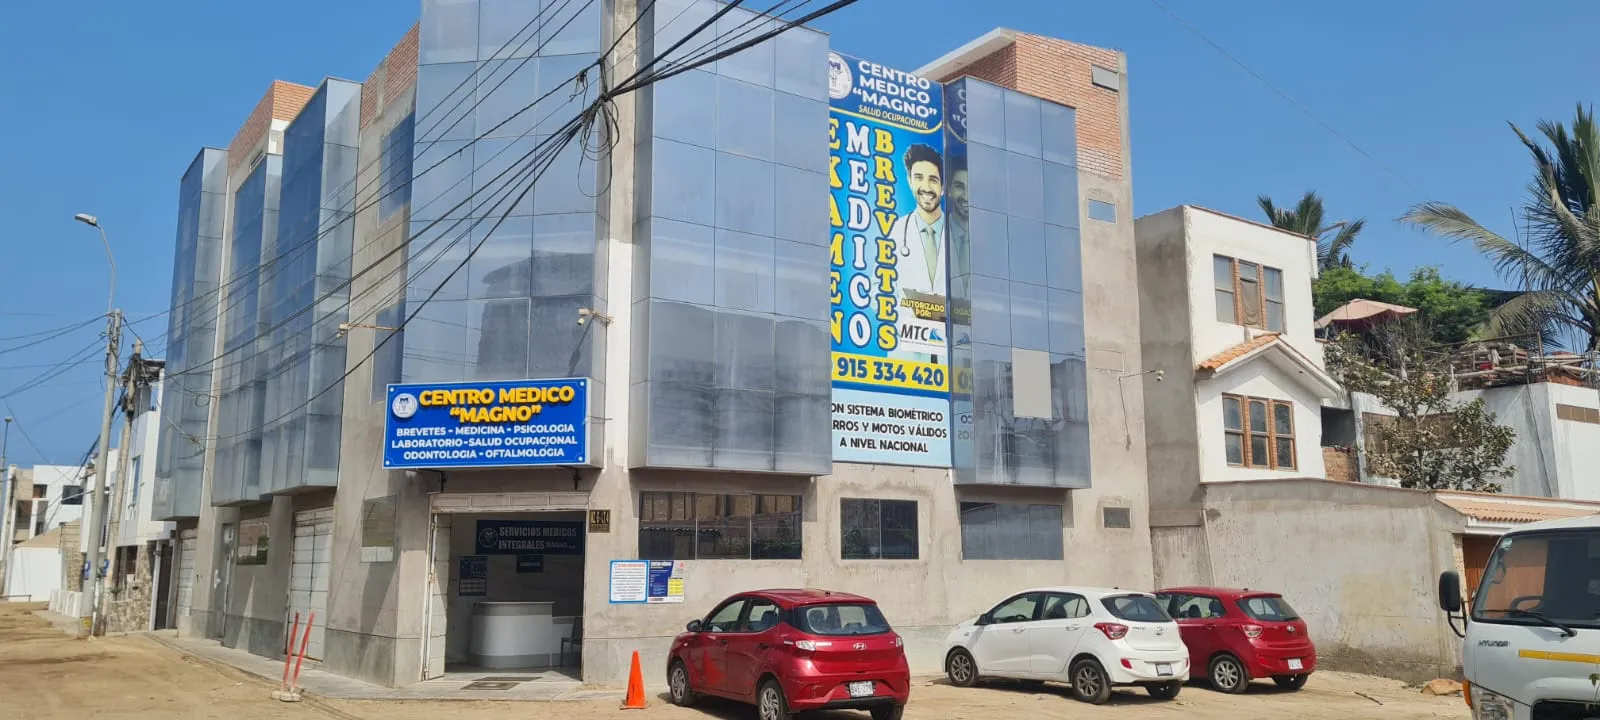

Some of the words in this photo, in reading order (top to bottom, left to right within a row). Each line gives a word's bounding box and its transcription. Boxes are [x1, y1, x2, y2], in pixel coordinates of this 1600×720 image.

[858, 60, 930, 90] CENTRO
[859, 75, 930, 103] MEDICO
[858, 104, 881, 118] SALUD
[882, 111, 928, 130] OCUPACIONAL
[875, 129, 896, 349] BREVETES
[901, 299, 944, 313] AUTORIZADO
[900, 324, 929, 341] MTC
[837, 357, 867, 379] 915
[873, 360, 906, 382] 334
[911, 367, 944, 386] 420
[419, 389, 495, 406] CENTRO
[499, 386, 575, 404] MEDICO
[832, 403, 844, 414] ON
[847, 404, 885, 418] SISTEMA
[888, 408, 943, 422] BIOMÉTRICO
[397, 427, 446, 437] BREVETES
[456, 425, 505, 436] MEDICINA
[514, 424, 574, 434] PSICOLOGIA
[832, 420, 859, 432] RROS
[862, 422, 869, 432] Y
[872, 422, 905, 435] MOTOS
[908, 425, 947, 438] VÁLIDOS
[505, 436, 577, 446] OCUPACIONAL
[840, 437, 847, 447] A
[851, 438, 877, 450] NIVEL
[880, 440, 928, 453] NACIONAL
[403, 450, 477, 460] ODONTOLOGIA
[485, 448, 564, 459] OFTALMOLOGIA
[499, 527, 541, 537] SERVICIOS
[543, 527, 577, 537] MEDICOS
[499, 539, 545, 550] INTEGRALES
